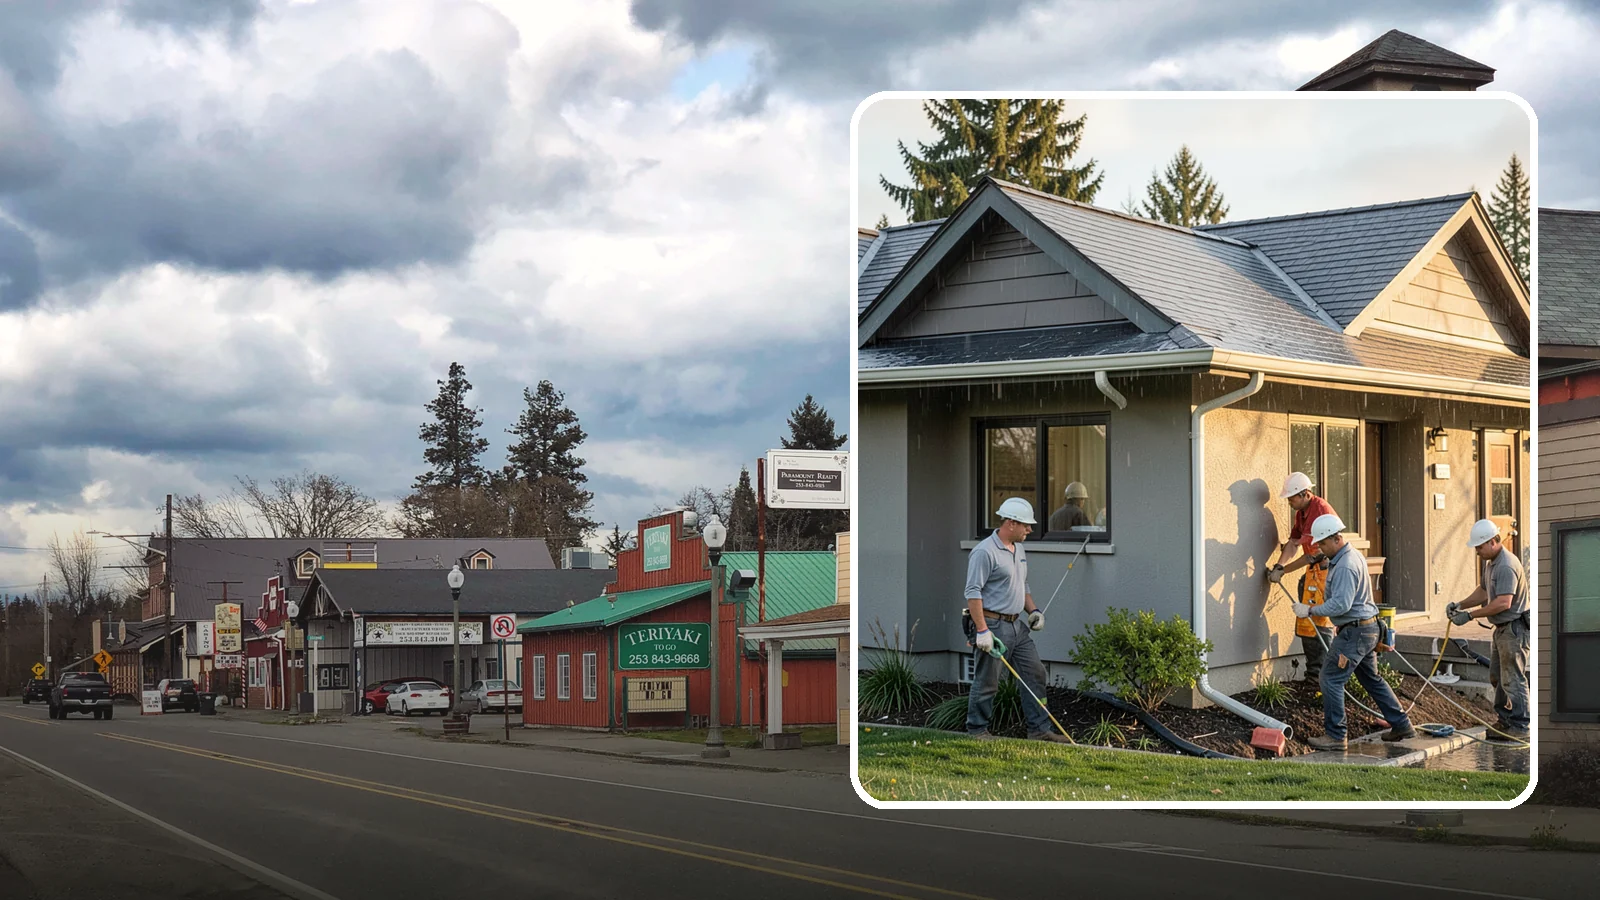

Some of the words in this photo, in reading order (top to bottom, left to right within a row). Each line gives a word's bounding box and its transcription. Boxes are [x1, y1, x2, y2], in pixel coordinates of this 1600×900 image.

[817, 472, 839, 480] REALTY
[624, 627, 703, 646] TERIYAKI
[628, 654, 649, 665] 253
[651, 653, 700, 664] 843-9668
[639, 681, 673, 691] TERIYAKI
